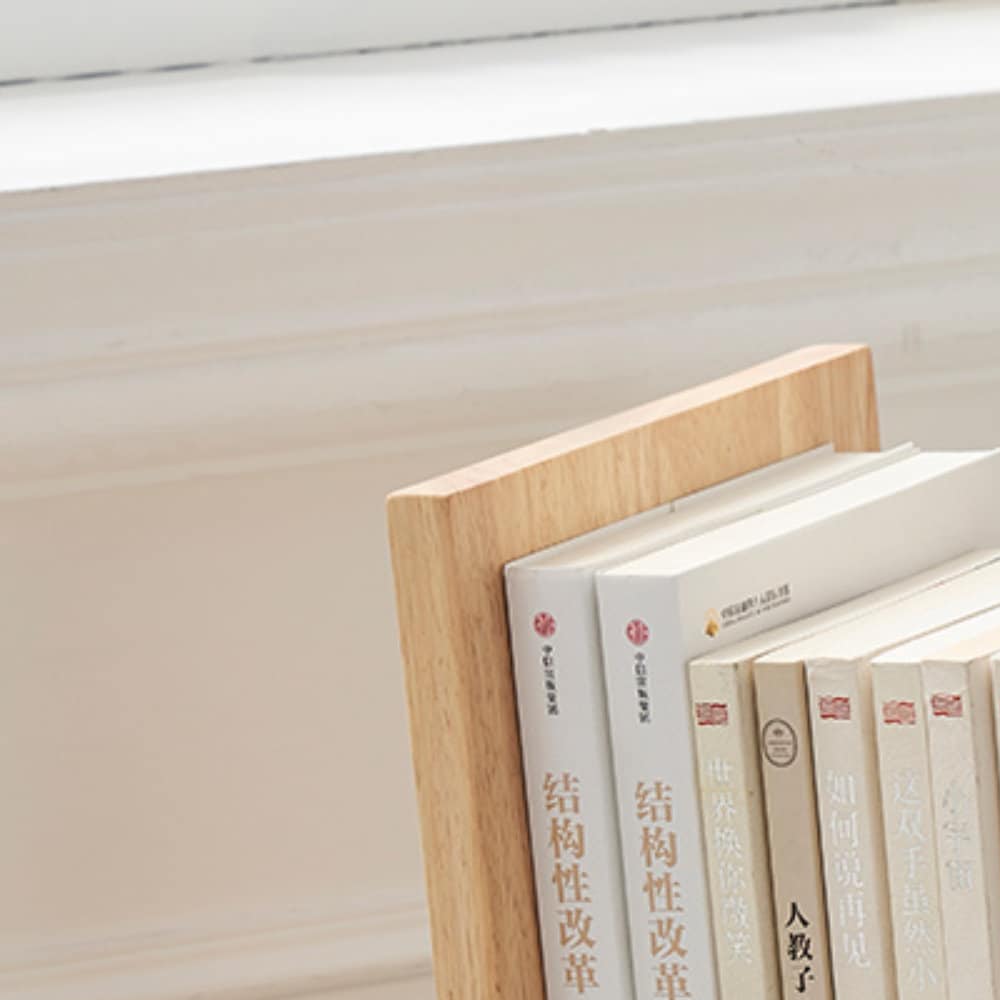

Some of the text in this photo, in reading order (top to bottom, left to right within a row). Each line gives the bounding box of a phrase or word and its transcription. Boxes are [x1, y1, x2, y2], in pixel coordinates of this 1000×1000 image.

[543, 772, 599, 995] 结构性改革
